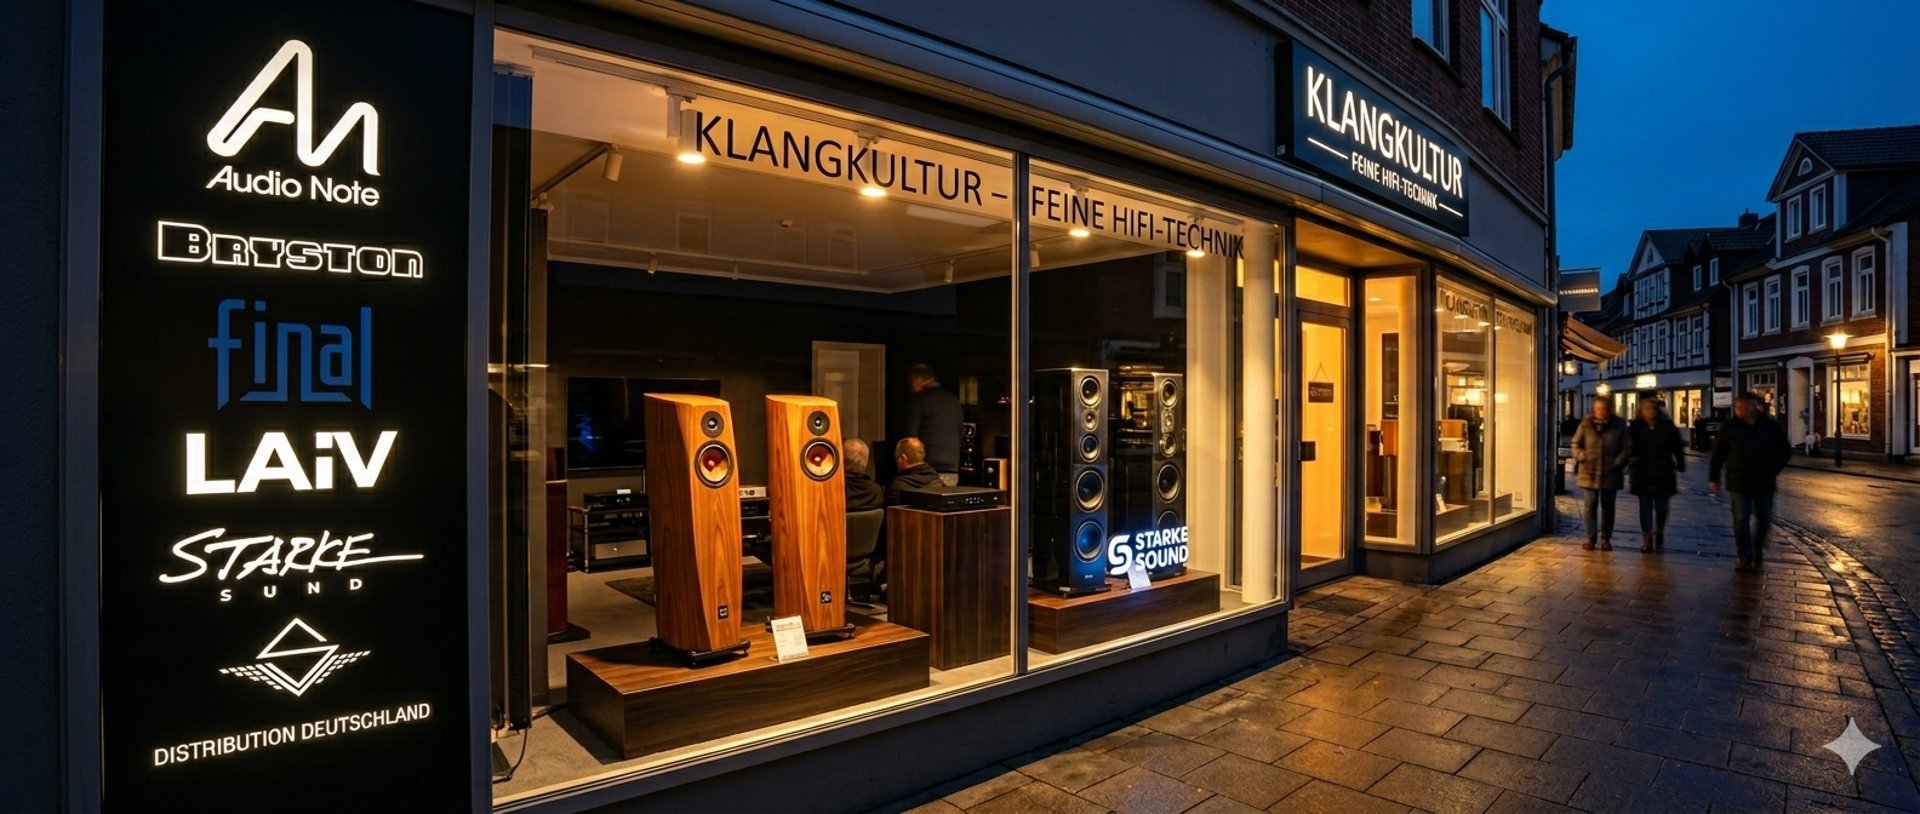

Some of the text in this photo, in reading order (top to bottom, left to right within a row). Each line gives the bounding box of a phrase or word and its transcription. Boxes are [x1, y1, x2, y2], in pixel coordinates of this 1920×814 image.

[1307, 65, 1464, 200] KLANGKULTUR
[205, 165, 381, 207] Audio Note
[696, 110, 983, 206] KLANGKULTUR
[1031, 185, 1105, 231] FEINE
[1113, 204, 1245, 260] HIFI-TECHNIK
[1351, 151, 1381, 184] FEINE
[208, 299, 372, 411] final
[158, 527, 425, 584] STARKE
[1135, 526, 1189, 551] STARKE
[1135, 545, 1189, 573] SOUND
[219, 578, 364, 602] SUND
[153, 702, 431, 767] DISTRIBUTION DEUTSCHLAND
